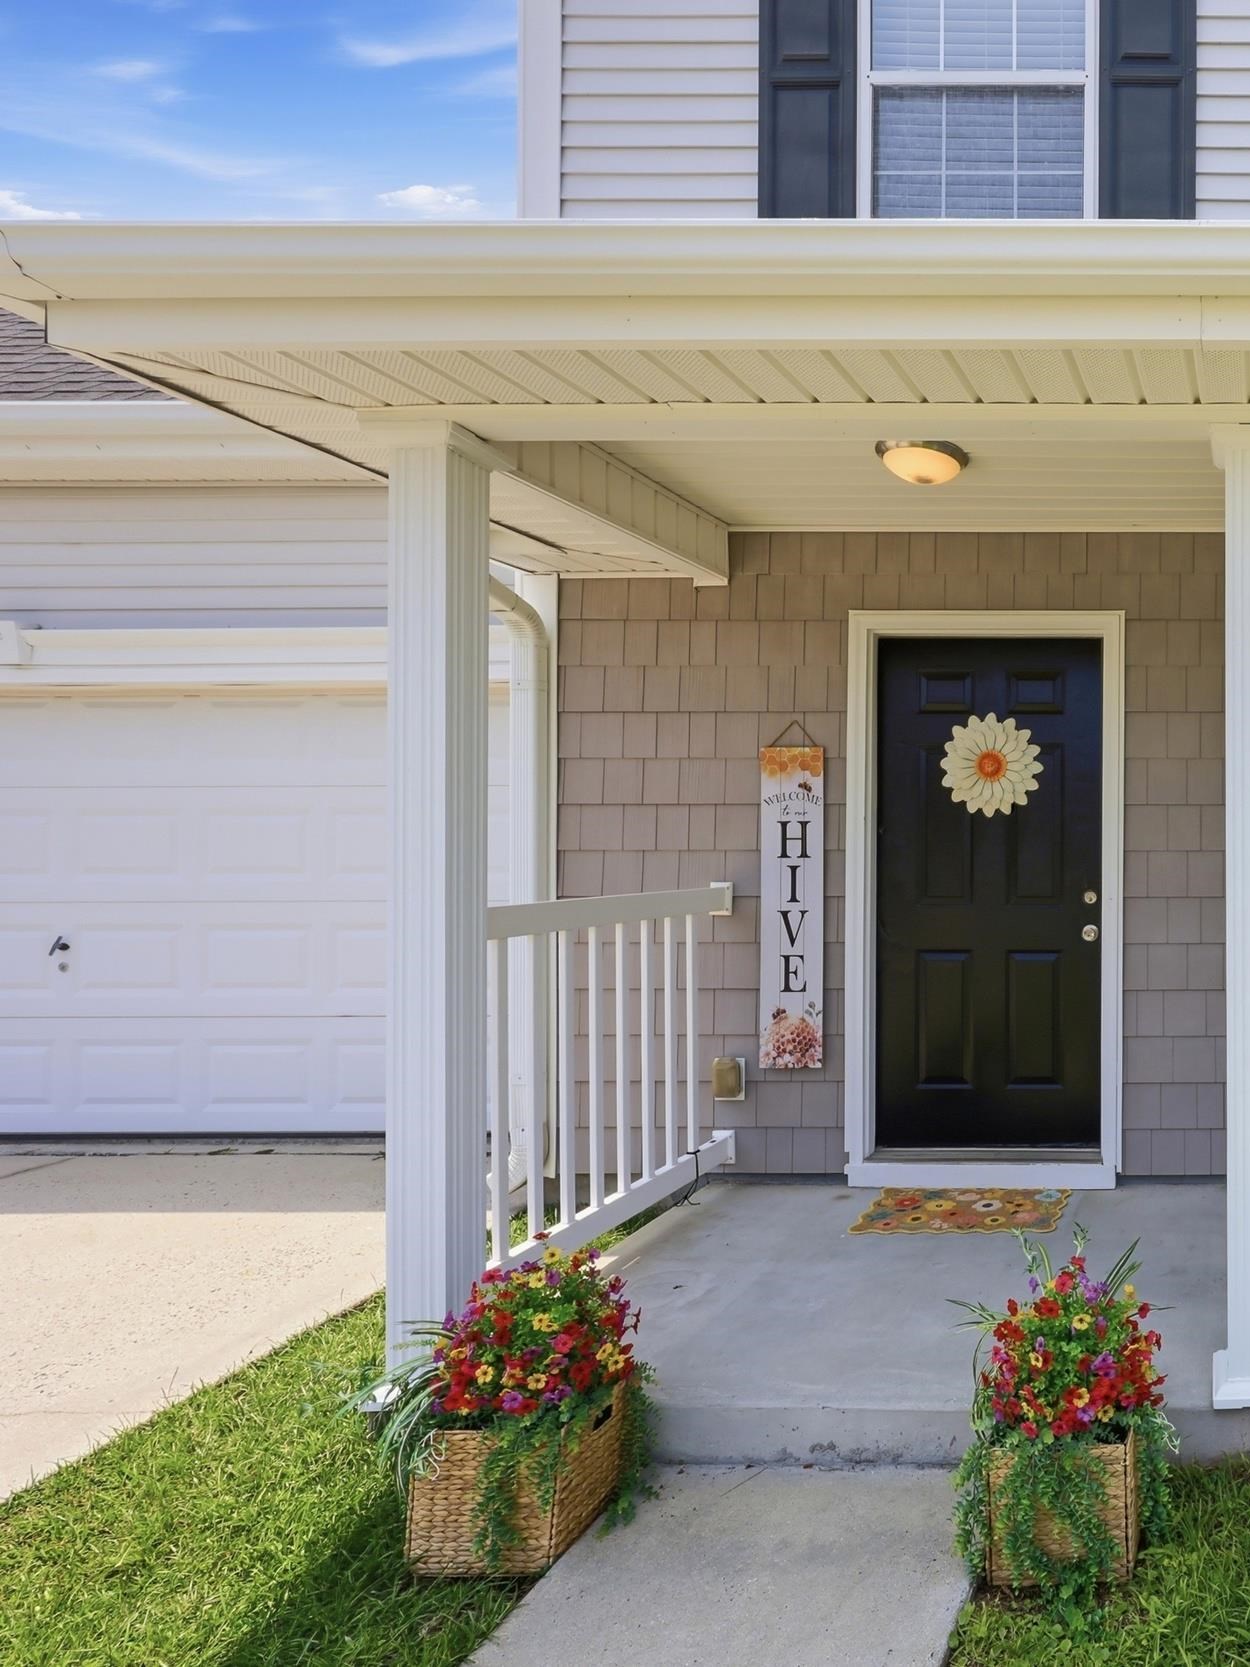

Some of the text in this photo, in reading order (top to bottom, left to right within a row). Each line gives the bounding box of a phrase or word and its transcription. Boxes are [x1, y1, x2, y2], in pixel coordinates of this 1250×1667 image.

[763, 791, 822, 806] WELCOME
[782, 804, 791, 816] to
[776, 820, 812, 992] HIVE
